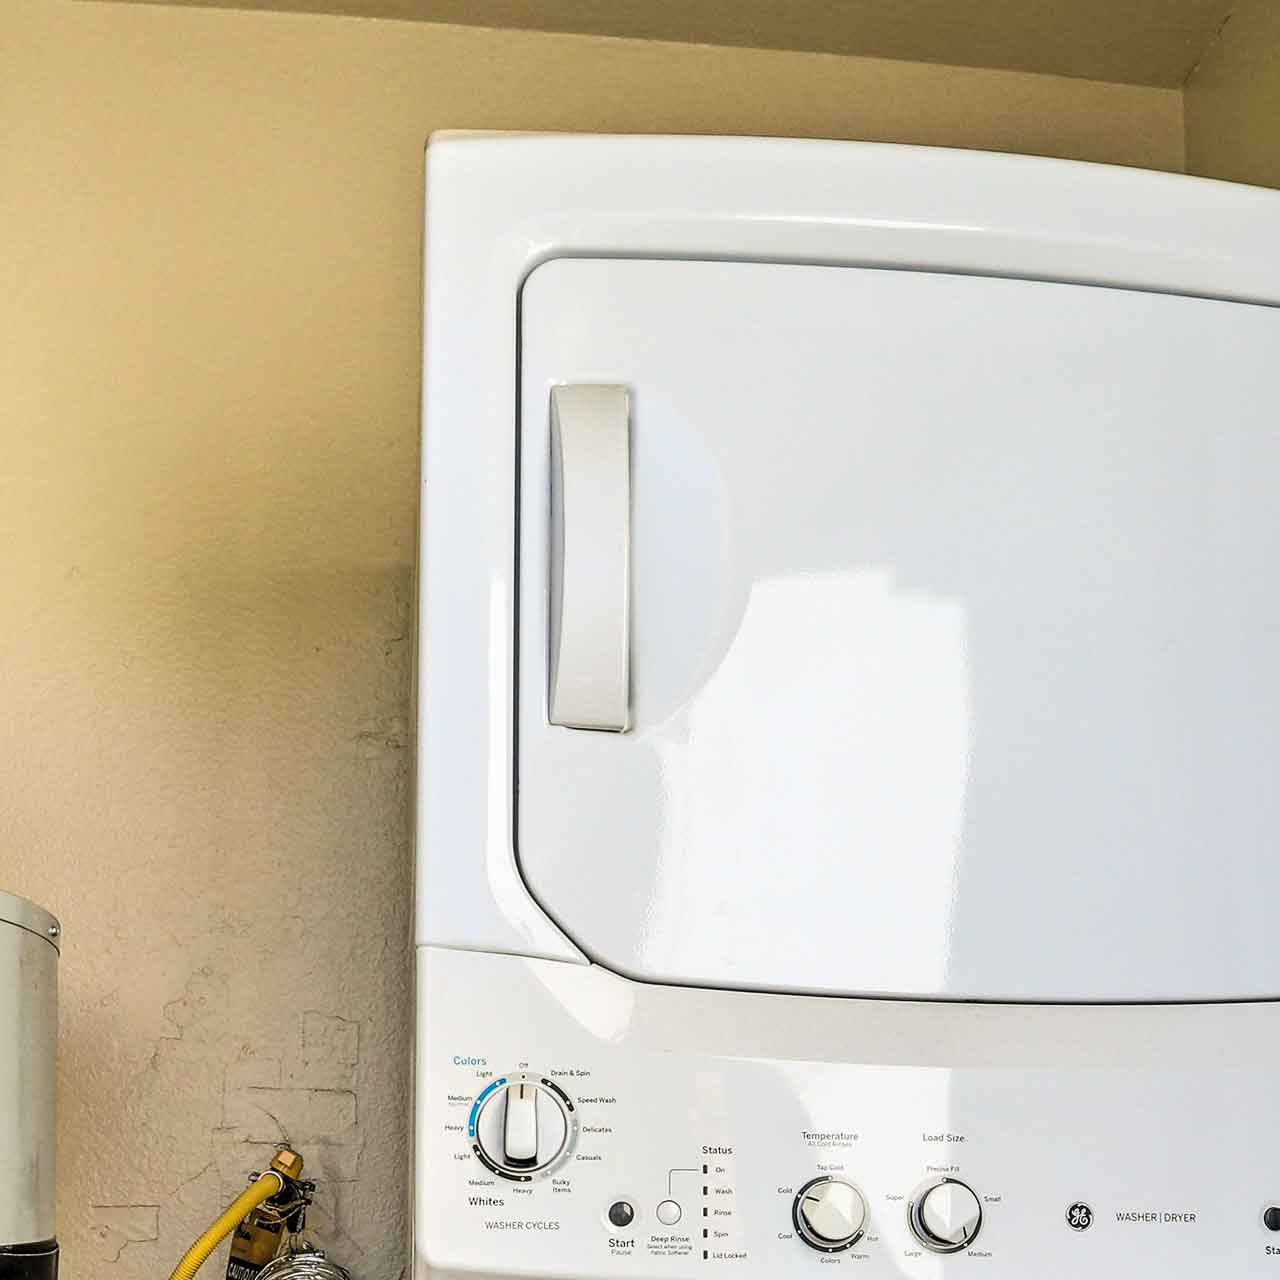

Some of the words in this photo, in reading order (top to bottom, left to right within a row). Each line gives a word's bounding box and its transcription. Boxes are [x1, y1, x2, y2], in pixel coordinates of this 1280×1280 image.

[453, 1056, 486, 1065] Colors
[802, 1131, 858, 1142] Temperature
[923, 1134, 944, 1142] Load
[946, 1134, 964, 1142] Size
[702, 1146, 732, 1154] Status
[468, 1198, 504, 1206] Whites
[1116, 1213, 1157, 1222] WASHER
[1165, 1213, 1196, 1223] DRYER
[485, 1222, 522, 1230] WASHER
[526, 1222, 559, 1230] CYCLES
[608, 1239, 634, 1248] Start
